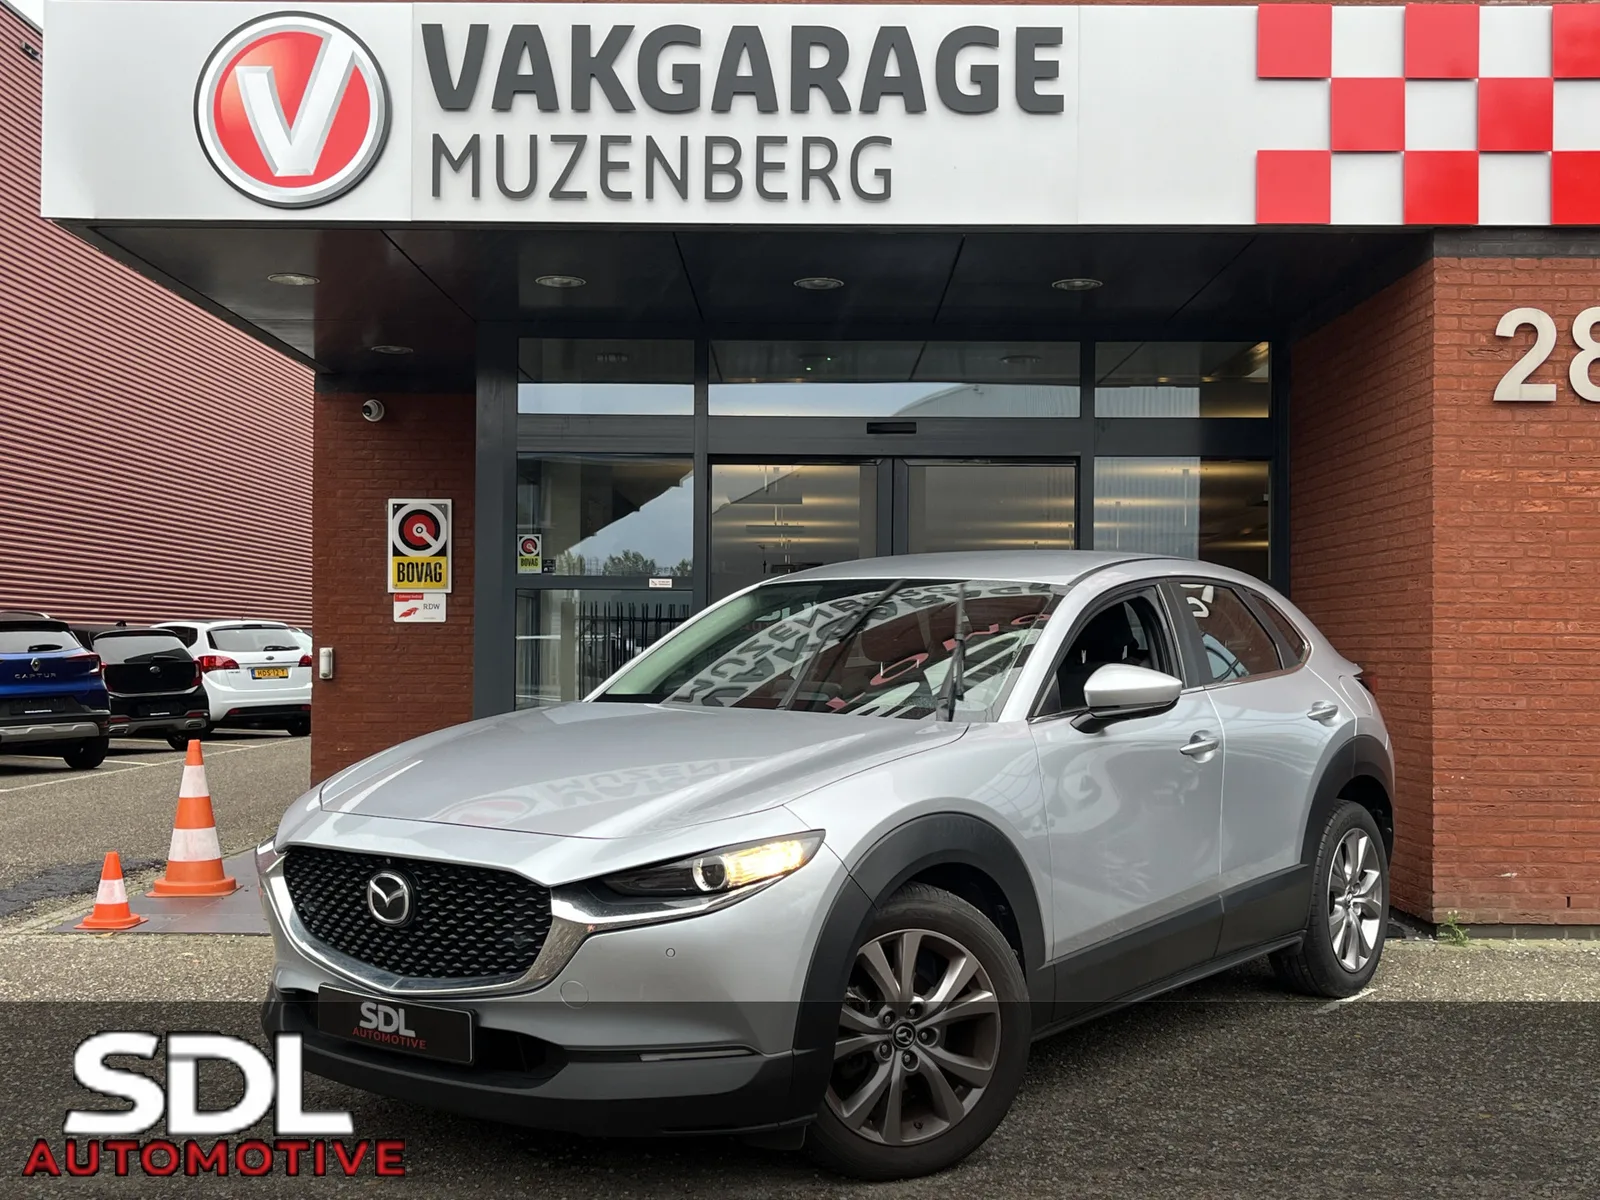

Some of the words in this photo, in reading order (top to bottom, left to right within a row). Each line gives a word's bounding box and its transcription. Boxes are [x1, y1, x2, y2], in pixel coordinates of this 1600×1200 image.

[421, 23, 1065, 114] VAKGARAGE
[431, 133, 893, 202] MUZENBERG
[397, 561, 443, 583] BOVAG
[520, 557, 539, 567] BOVAG
[359, 1001, 416, 1037] SDL
[352, 1027, 427, 1049] AUTOMOTIVE
